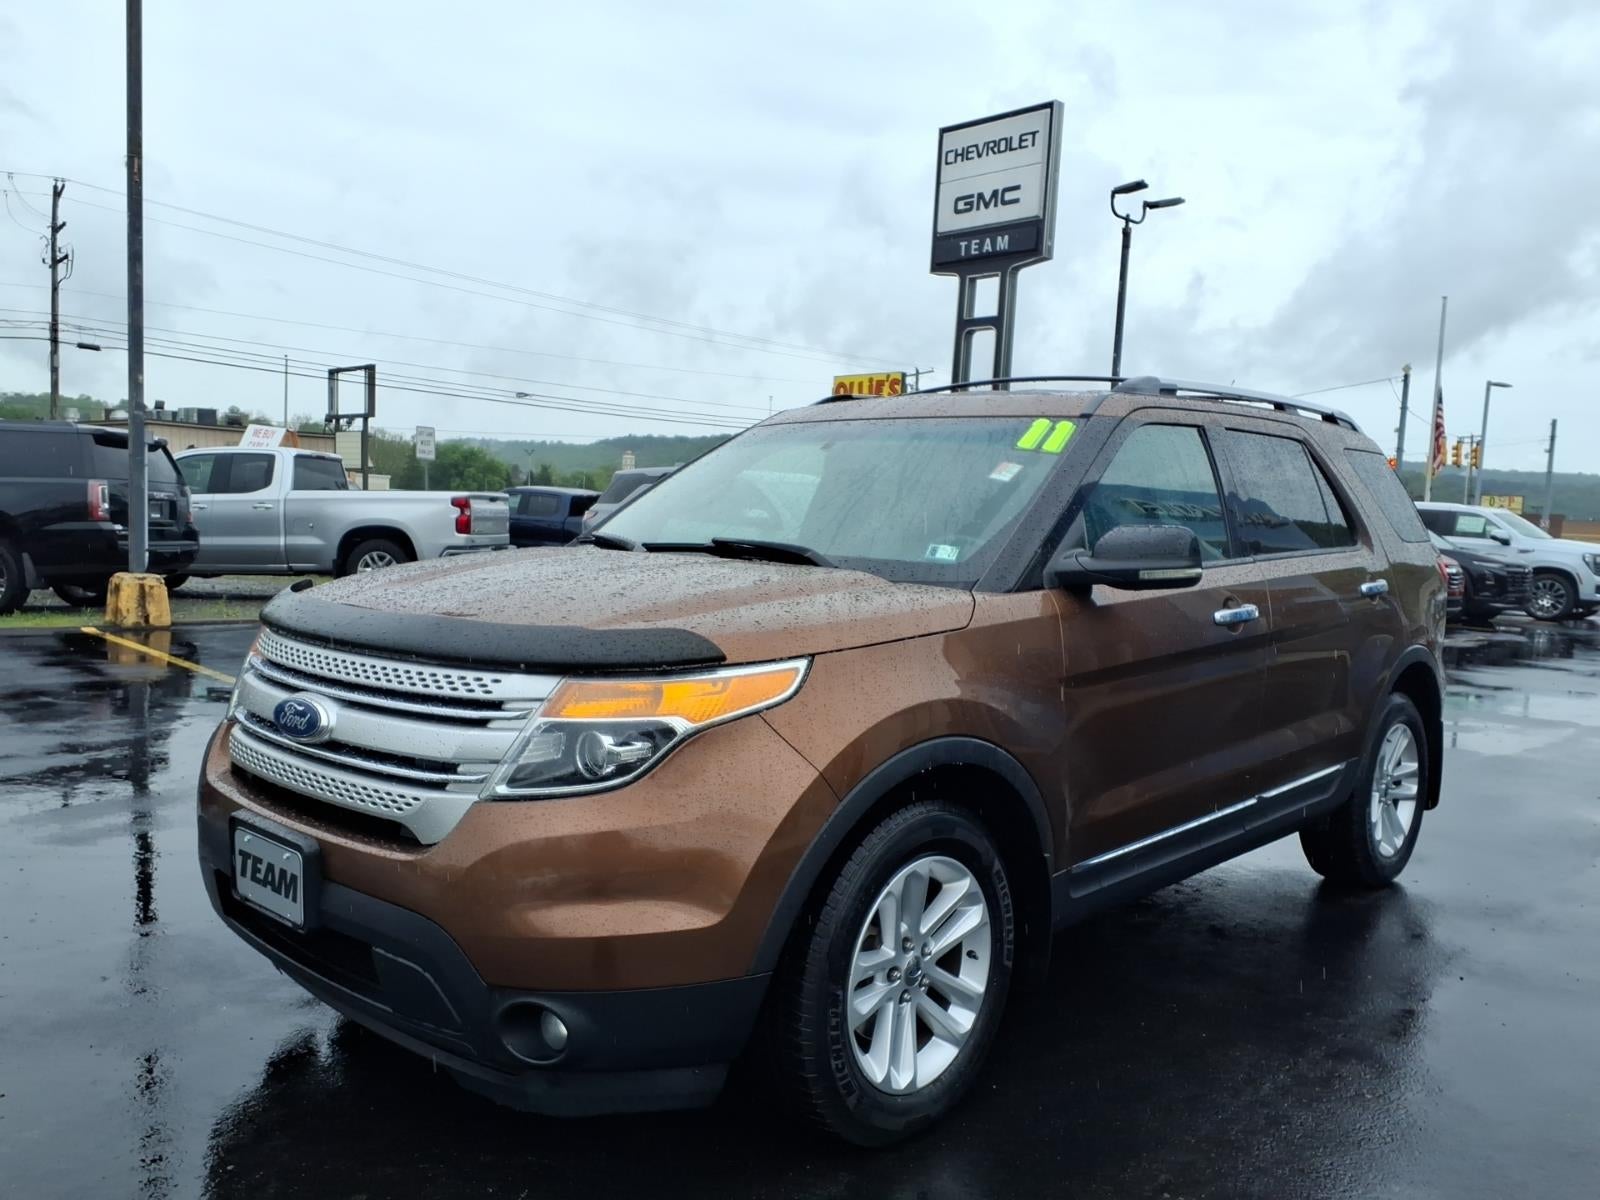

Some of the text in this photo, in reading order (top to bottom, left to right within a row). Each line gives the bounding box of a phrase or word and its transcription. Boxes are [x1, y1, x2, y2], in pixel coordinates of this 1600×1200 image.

[944, 130, 1040, 166] CHEVROLET
[953, 184, 1022, 215] GMC
[959, 235, 1009, 257] TEAM
[1015, 418, 1077, 453] 11
[280, 701, 311, 730] Ford
[238, 851, 298, 904] TEAM
